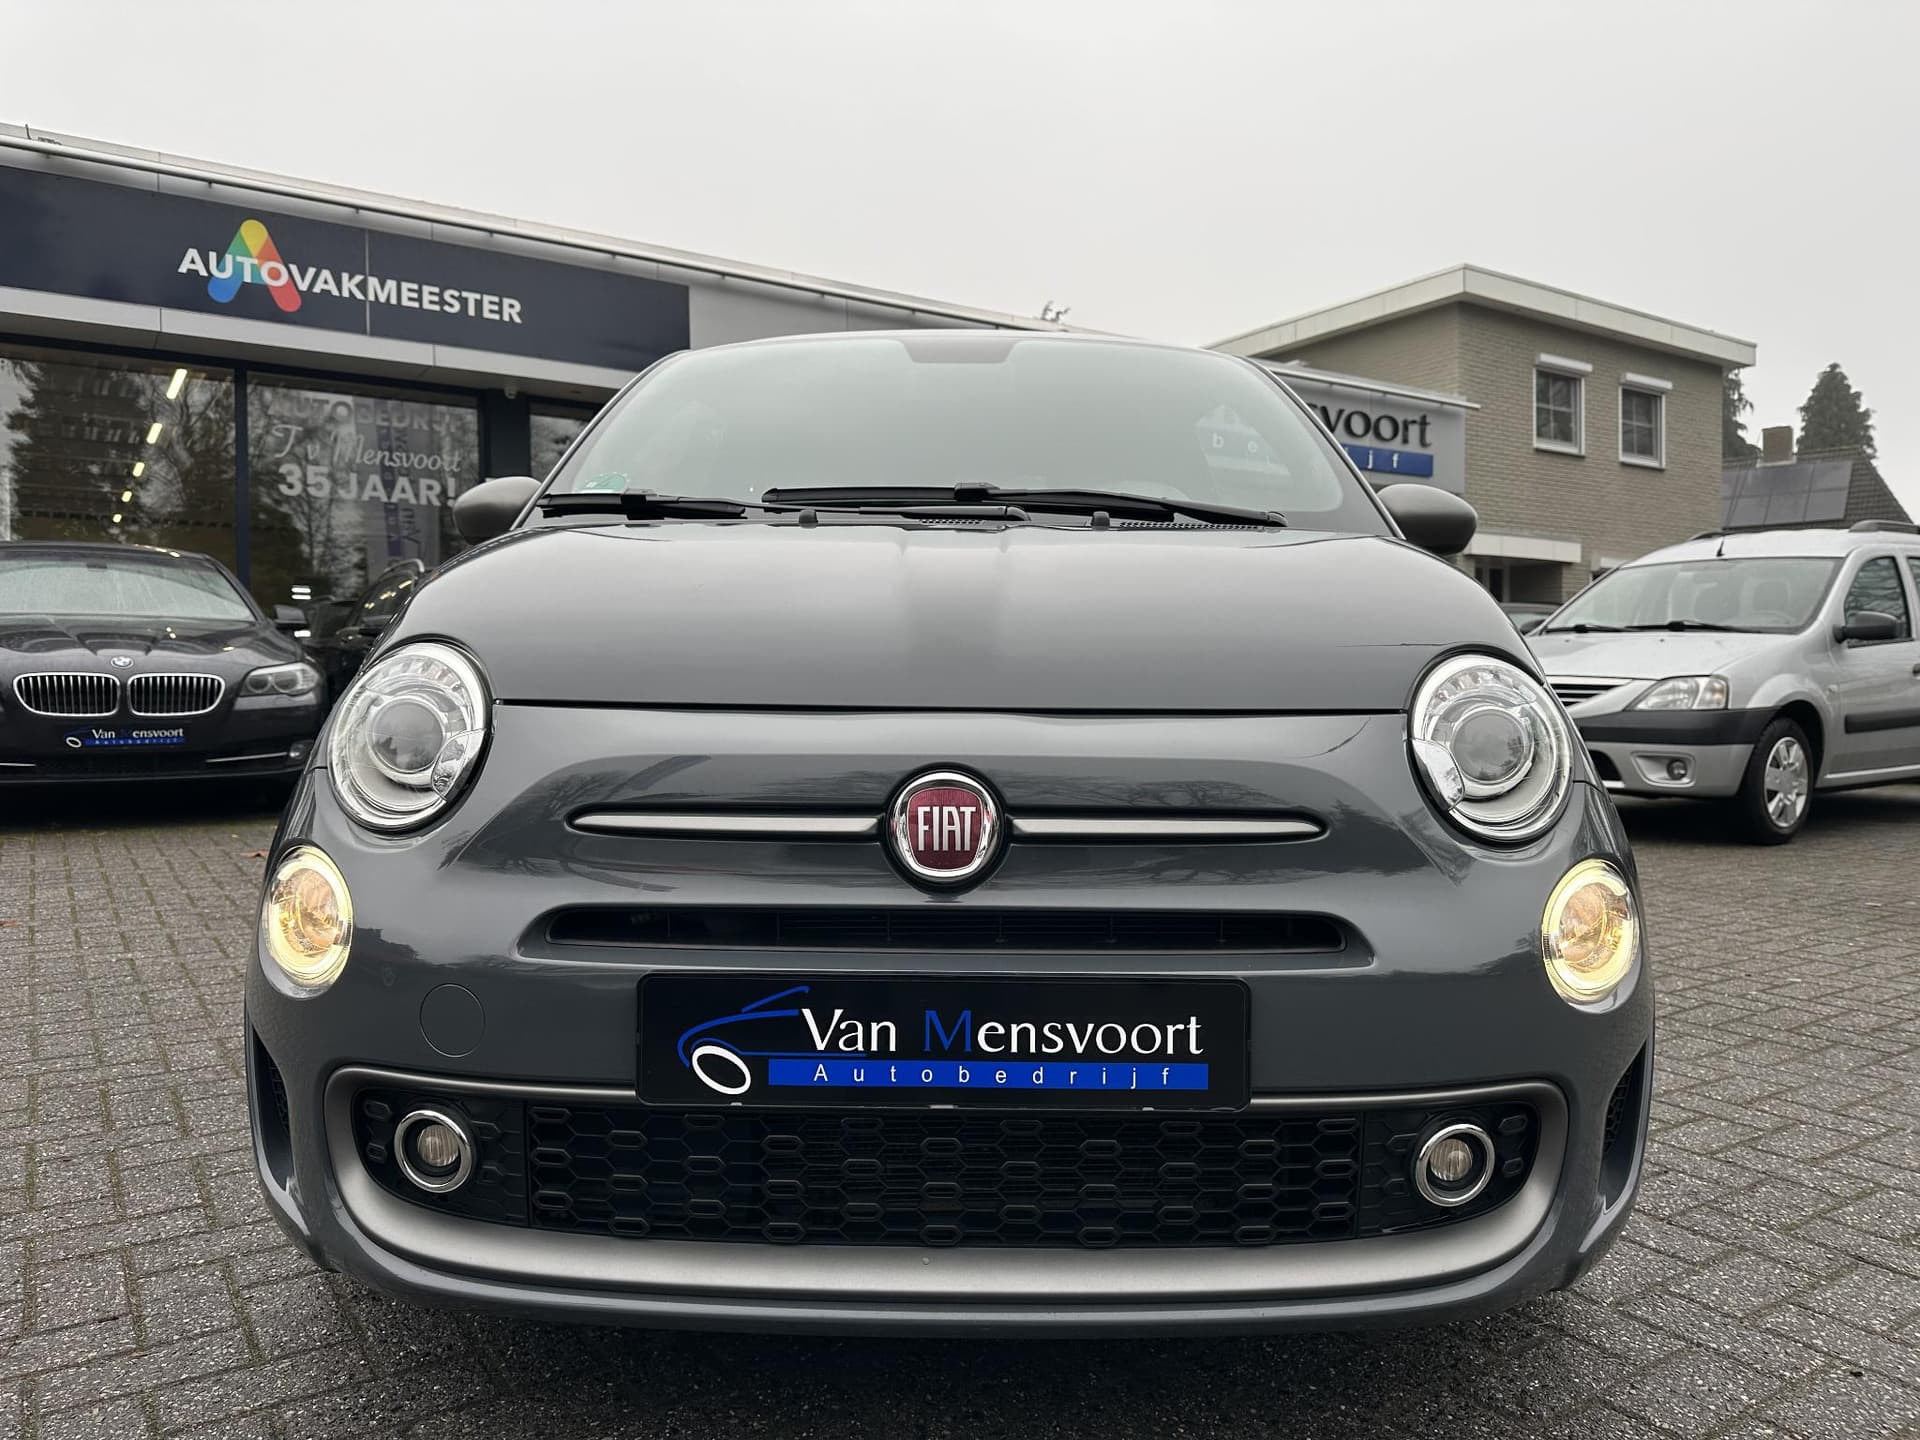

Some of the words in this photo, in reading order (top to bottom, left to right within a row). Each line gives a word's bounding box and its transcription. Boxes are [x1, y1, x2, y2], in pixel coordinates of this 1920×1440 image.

[178, 246, 523, 325] AUTOVAKMEESTER
[1306, 402, 1432, 448] voort
[277, 463, 331, 498] 35
[337, 471, 457, 508] JAAR!
[91, 728, 116, 740] Van
[916, 805, 977, 852] FIAT
[801, 1008, 897, 1052] Van
[924, 1009, 1204, 1055] Mensvoort
[814, 1063, 1171, 1089] Autobedrijf
